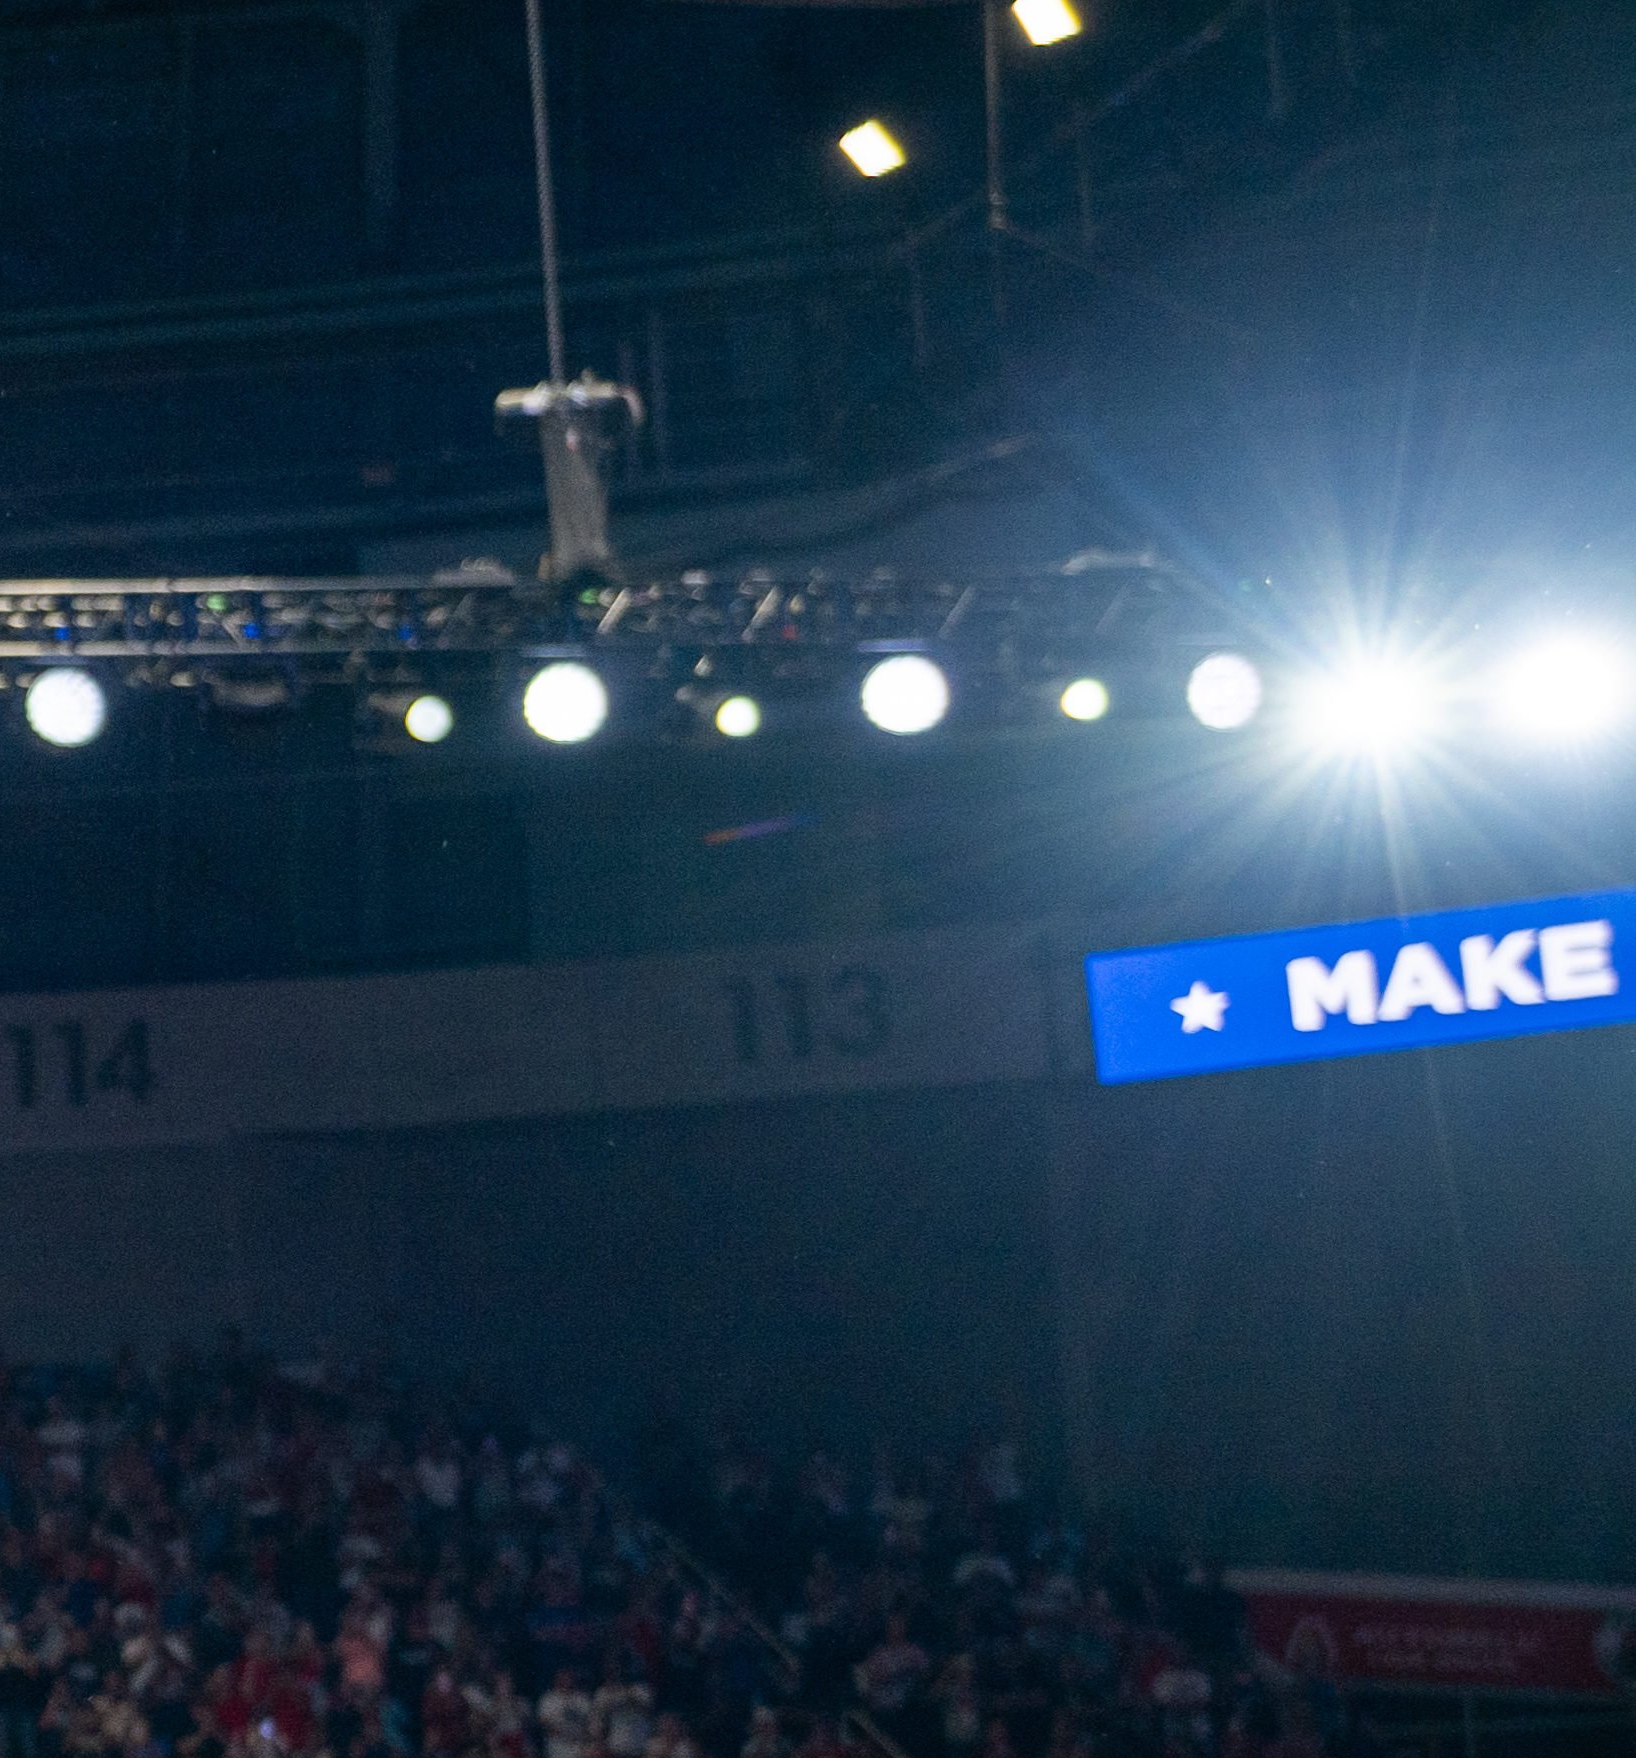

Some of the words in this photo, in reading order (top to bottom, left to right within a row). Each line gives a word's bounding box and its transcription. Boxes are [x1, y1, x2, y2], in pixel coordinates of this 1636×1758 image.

[722, 966, 888, 1061] 113
[1286, 919, 1619, 1032] MAKE
[5, 1020, 155, 1108] 114
